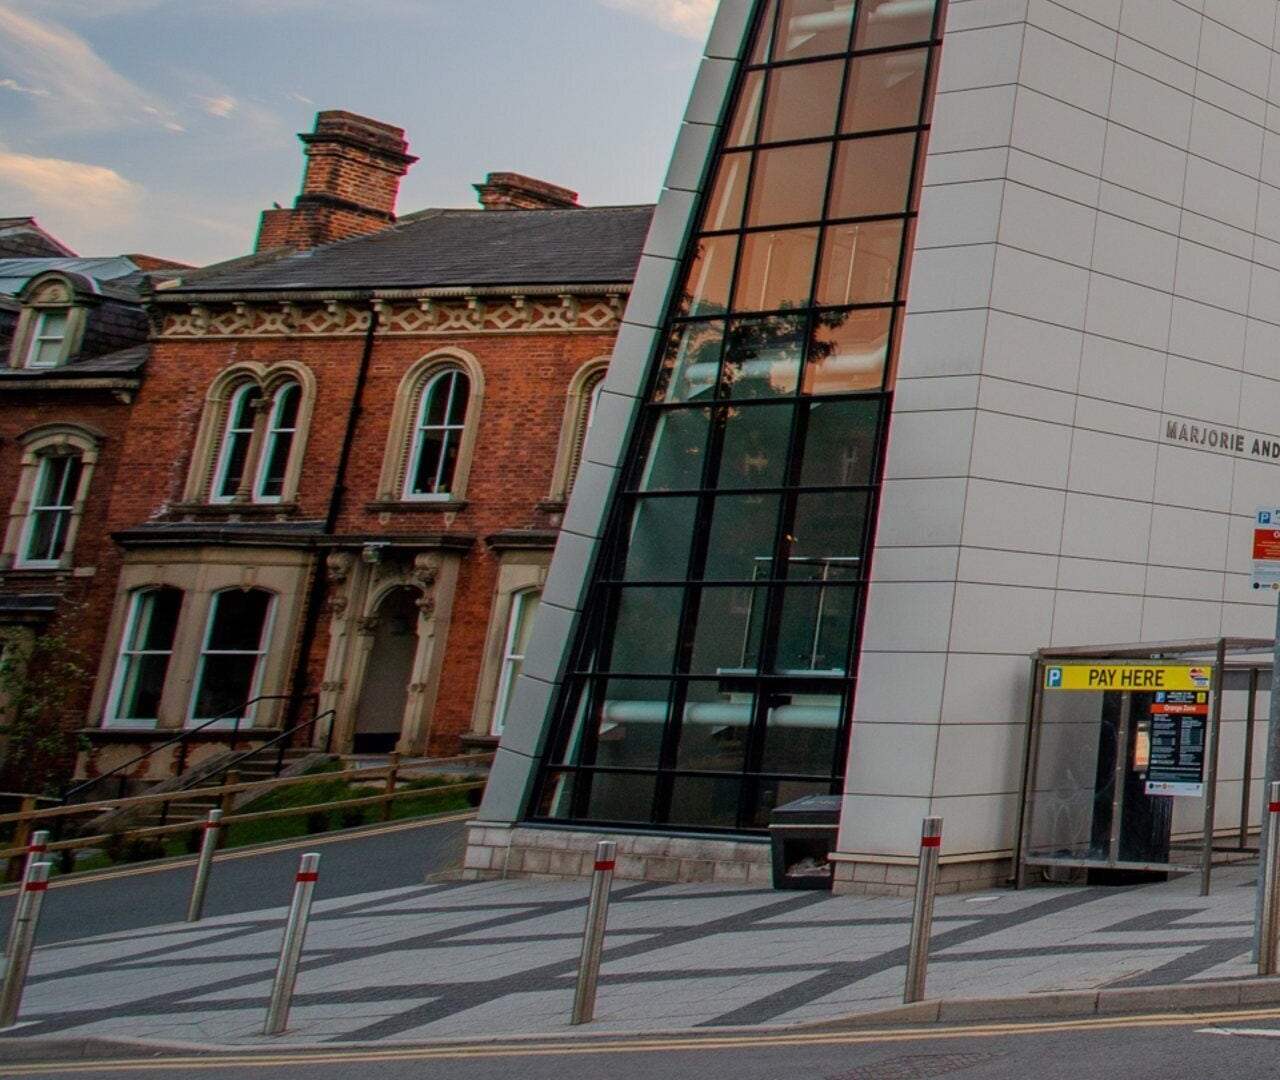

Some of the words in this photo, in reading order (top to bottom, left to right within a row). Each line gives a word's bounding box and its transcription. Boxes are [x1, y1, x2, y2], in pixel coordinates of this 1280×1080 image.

[1166, 420, 1245, 452] MARJORIE
[1251, 439, 1280, 458] AND
[1049, 670, 1060, 686] P
[1088, 669, 1117, 686] PAY
[1121, 669, 1166, 687] HERE
